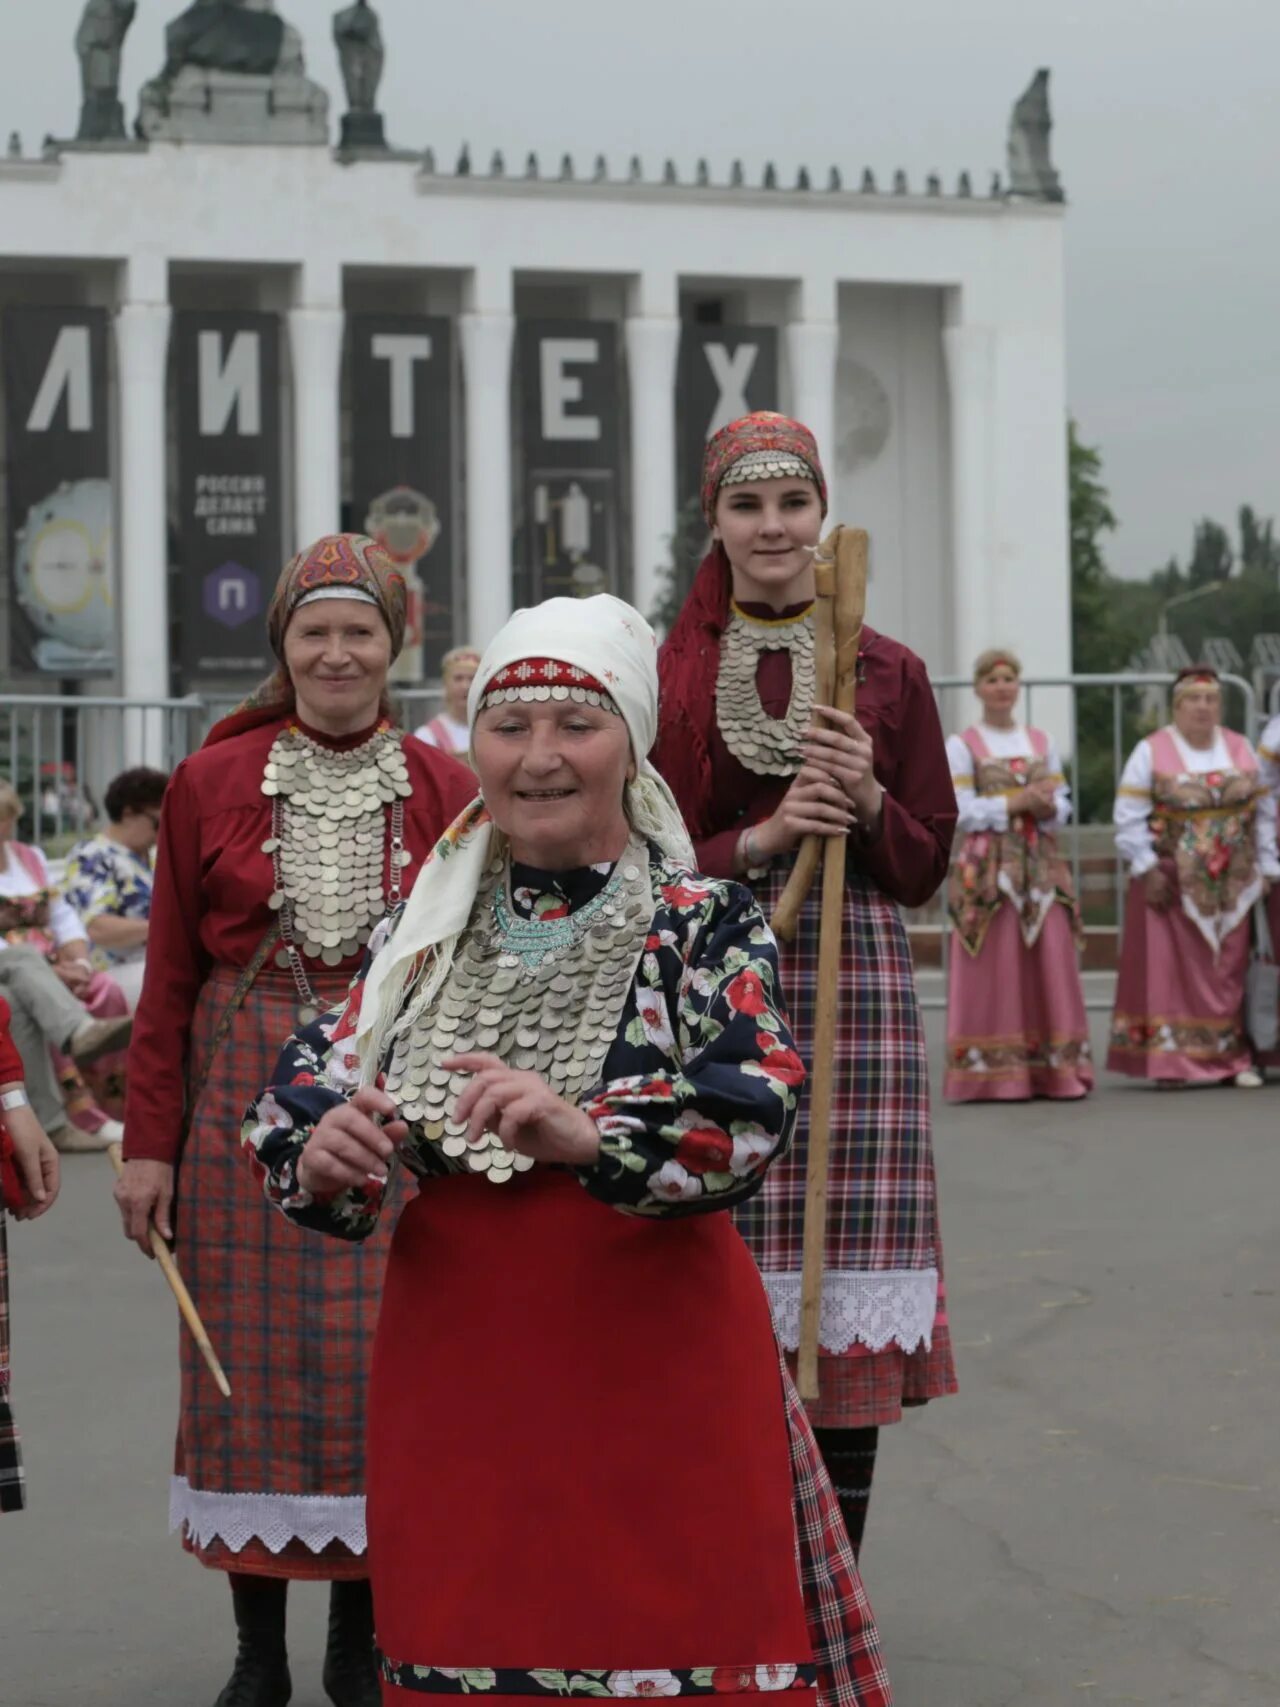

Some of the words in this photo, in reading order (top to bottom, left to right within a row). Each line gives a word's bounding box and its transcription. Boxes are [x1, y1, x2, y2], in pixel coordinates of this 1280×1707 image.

[196, 475, 265, 494] РОССИЯ
[194, 497, 266, 516] ДЕЛАЕТ
[206, 517, 257, 536] САМА
